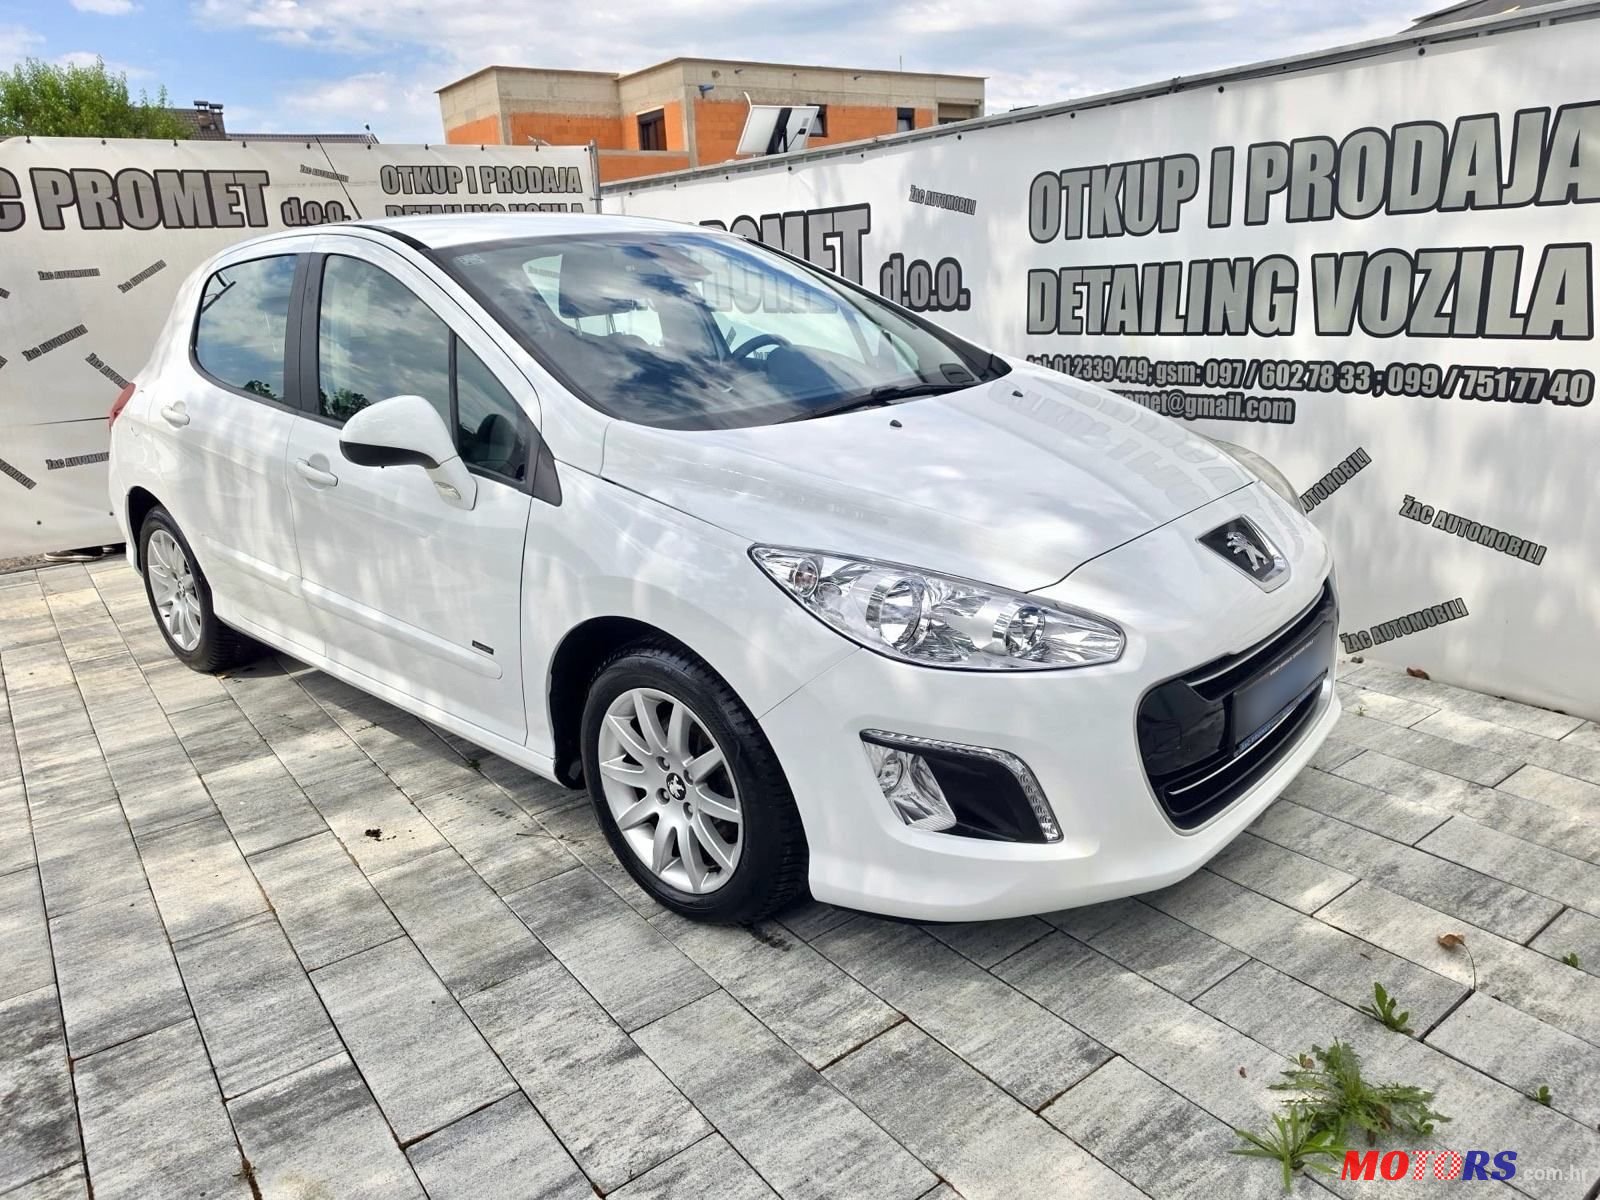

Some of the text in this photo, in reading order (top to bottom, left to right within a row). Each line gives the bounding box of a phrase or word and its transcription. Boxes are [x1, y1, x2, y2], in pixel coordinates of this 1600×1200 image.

[29, 167, 270, 230] PROMET
[280, 196, 352, 227] d.o.o.
[380, 165, 584, 194] OTKUP I PRODAJA
[1028, 100, 1600, 243] OTKUP I PRODAJA
[924, 190, 977, 215] AUTOMOBILI
[880, 252, 971, 312] d.o.o.
[1026, 242, 1594, 340] DETAILING VOZILA
[1153, 360, 1202, 388] gsm:
[1202, 358, 1247, 388] 097
[1385, 363, 1442, 395] 099
[1299, 447, 1372, 514] UTOMOBILI
[1398, 494, 1547, 566] ŽAC AUTOMOBILI
[1339, 597, 1469, 654] ŽAC AUTOMOBILI
